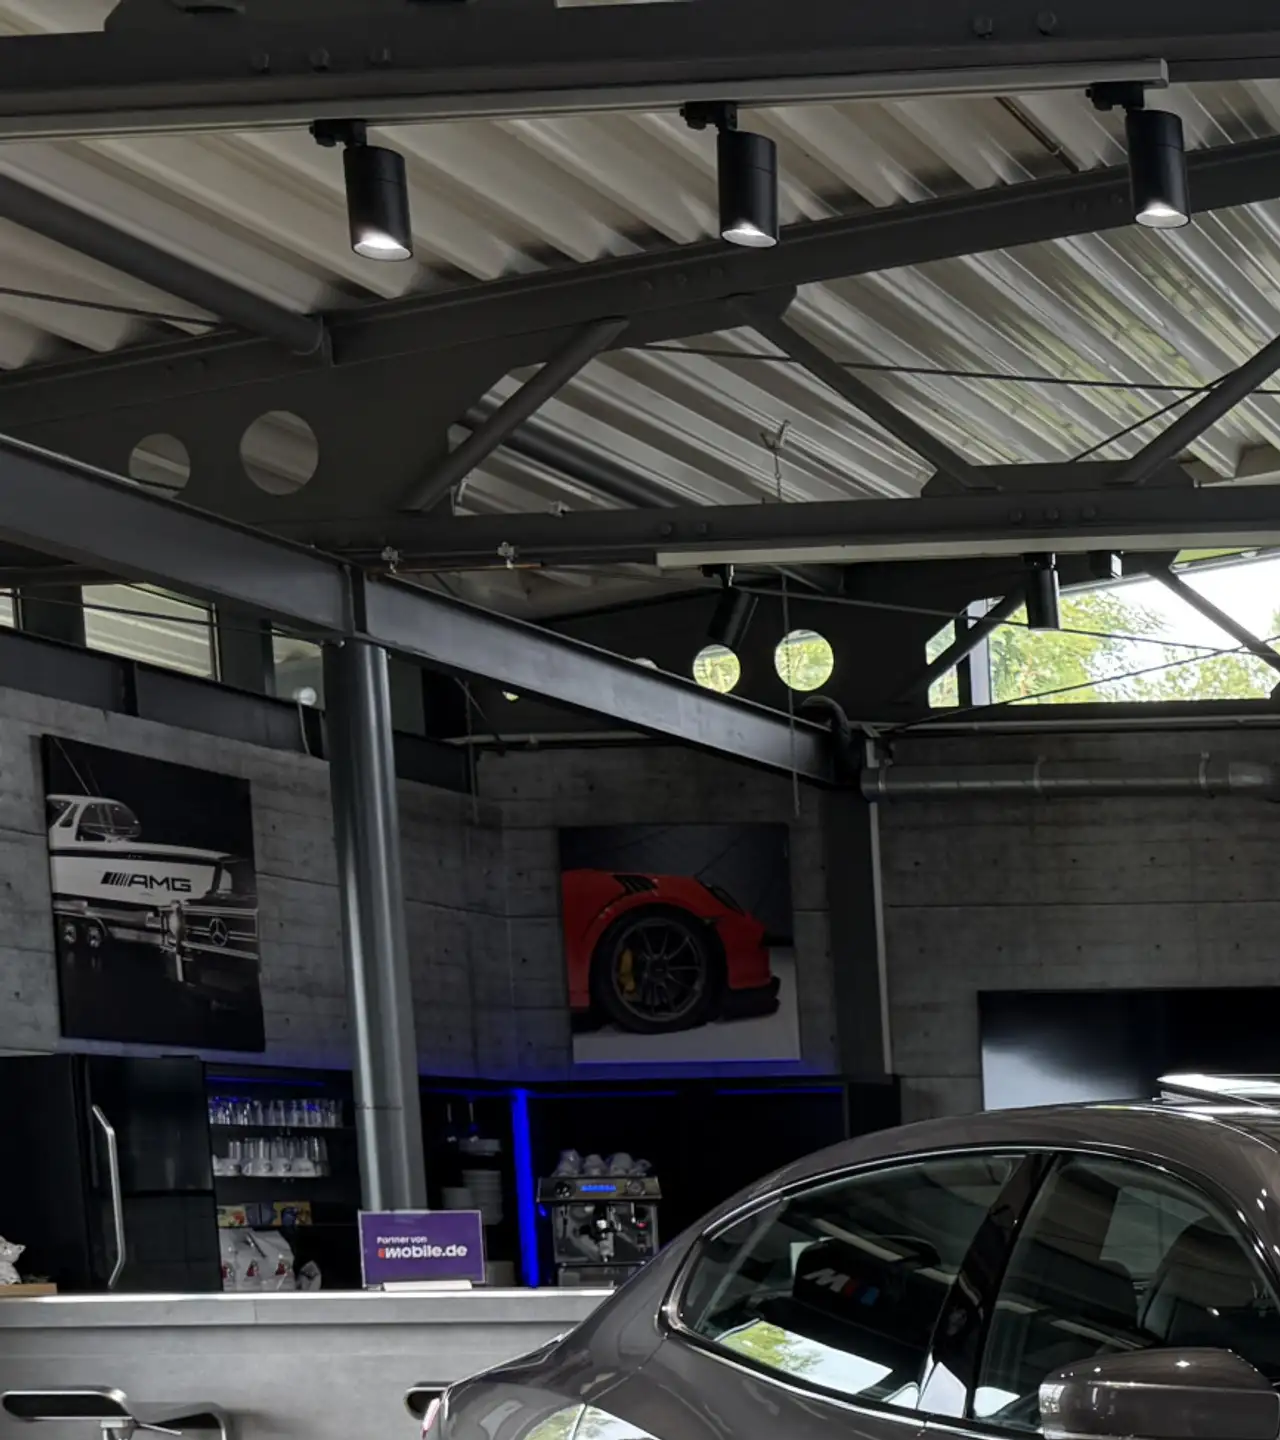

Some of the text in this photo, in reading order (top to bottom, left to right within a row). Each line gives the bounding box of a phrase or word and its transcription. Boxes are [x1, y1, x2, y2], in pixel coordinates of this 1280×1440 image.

[127, 873, 193, 893] AMG
[377, 1236, 428, 1244] Partner von
[385, 1244, 468, 1259] mobile.de
